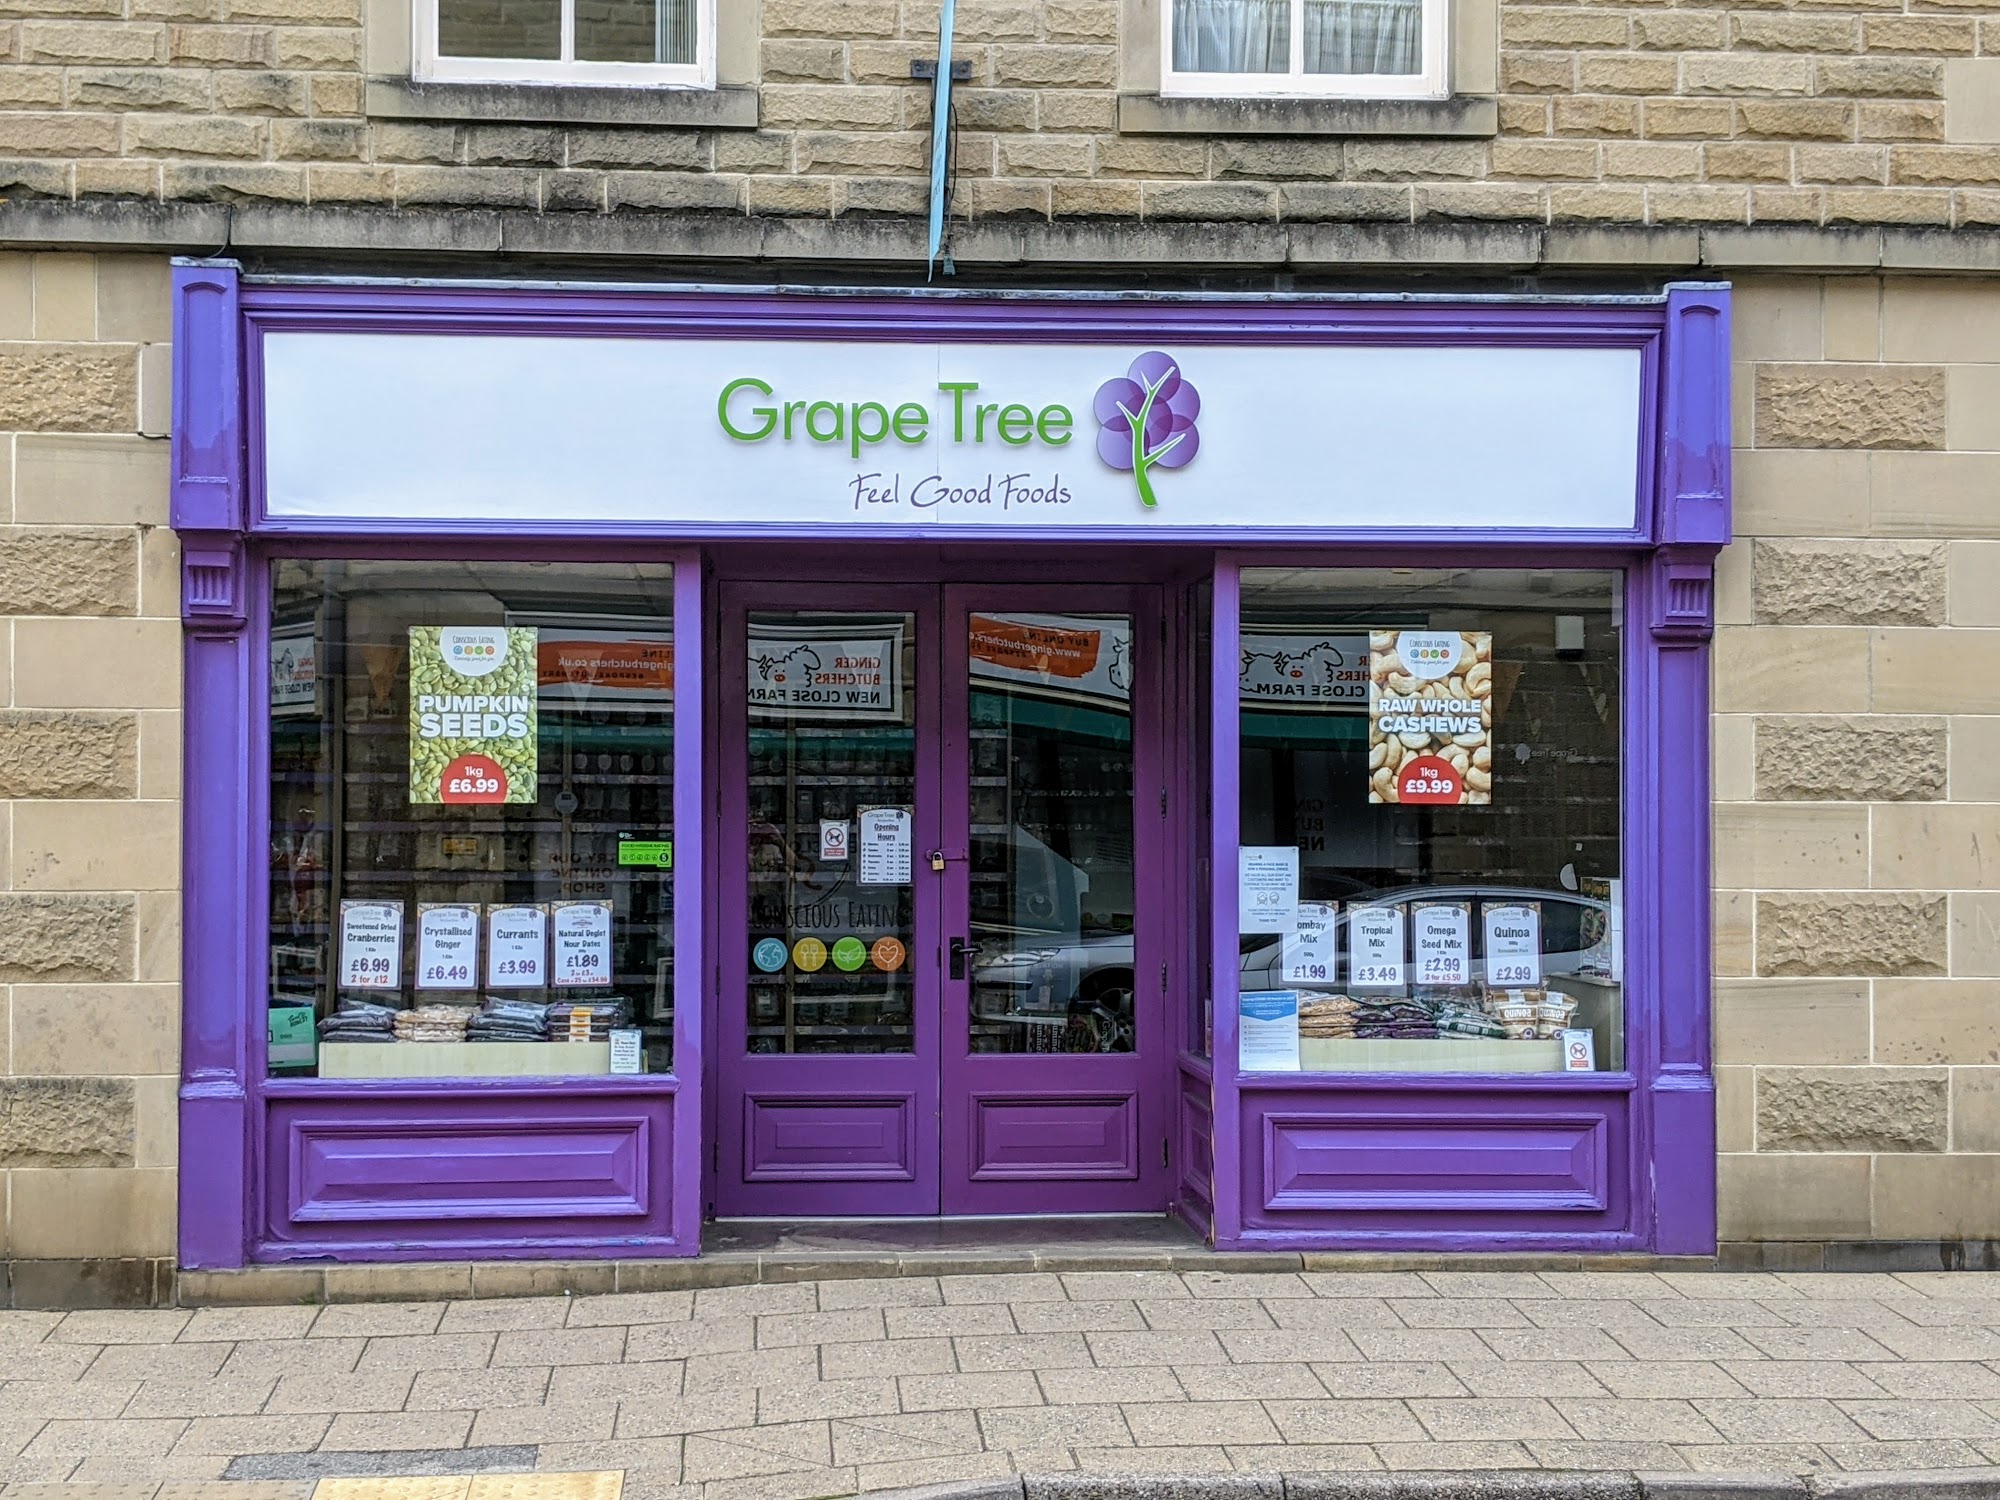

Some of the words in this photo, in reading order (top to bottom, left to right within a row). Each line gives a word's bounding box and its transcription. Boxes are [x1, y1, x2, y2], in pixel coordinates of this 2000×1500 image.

[718, 377, 929, 458] Grape
[938, 382, 1073, 445] Tree
[848, 473, 899, 510] Feel
[910, 475, 992, 509] Good
[998, 473, 1072, 509] Foods
[1410, 640, 1433, 648] CONSCIOUS
[1434, 640, 1450, 648] EATING
[420, 696, 528, 712] PUMPKIN
[1378, 699, 1416, 712] RAW
[1420, 699, 1482, 712] WHOLE
[420, 714, 528, 738] SEEDS
[1378, 716, 1482, 732] CASHEWS
[464, 766, 484, 778] 1kg
[1420, 767, 1438, 778] 1kg
[449, 778, 498, 794] £6.99
[1406, 780, 1453, 794] £9.99
[874, 823, 899, 831] Opening
[1297, 920, 1326, 930] ombay
[1361, 926, 1393, 935] Tropical
[1427, 926, 1456, 936] Omega
[347, 933, 395, 943] Cranberries
[424, 927, 472, 937] Crystallised
[497, 929, 538, 939] Currants
[586, 929, 606, 938] Deglet
[1494, 926, 1530, 938] Quinoa
[435, 940, 461, 949] Ginger
[1300, 934, 1318, 943] Mix
[1369, 938, 1385, 947] Mix
[1422, 939, 1441, 948] Seed
[1445, 940, 1462, 948] Mix
[351, 958, 390, 972] £6.99
[498, 960, 536, 974] £3.99
[566, 954, 599, 968] £1.89
[1425, 958, 1460, 972] £2.99
[426, 966, 468, 980] £6.49
[1293, 965, 1326, 978] £1.99
[1358, 967, 1396, 981] £3.49
[1496, 967, 1531, 980] £2.99
[351, 974, 356, 983] 2
[359, 975, 370, 984] for
[374, 975, 388, 983] £12
